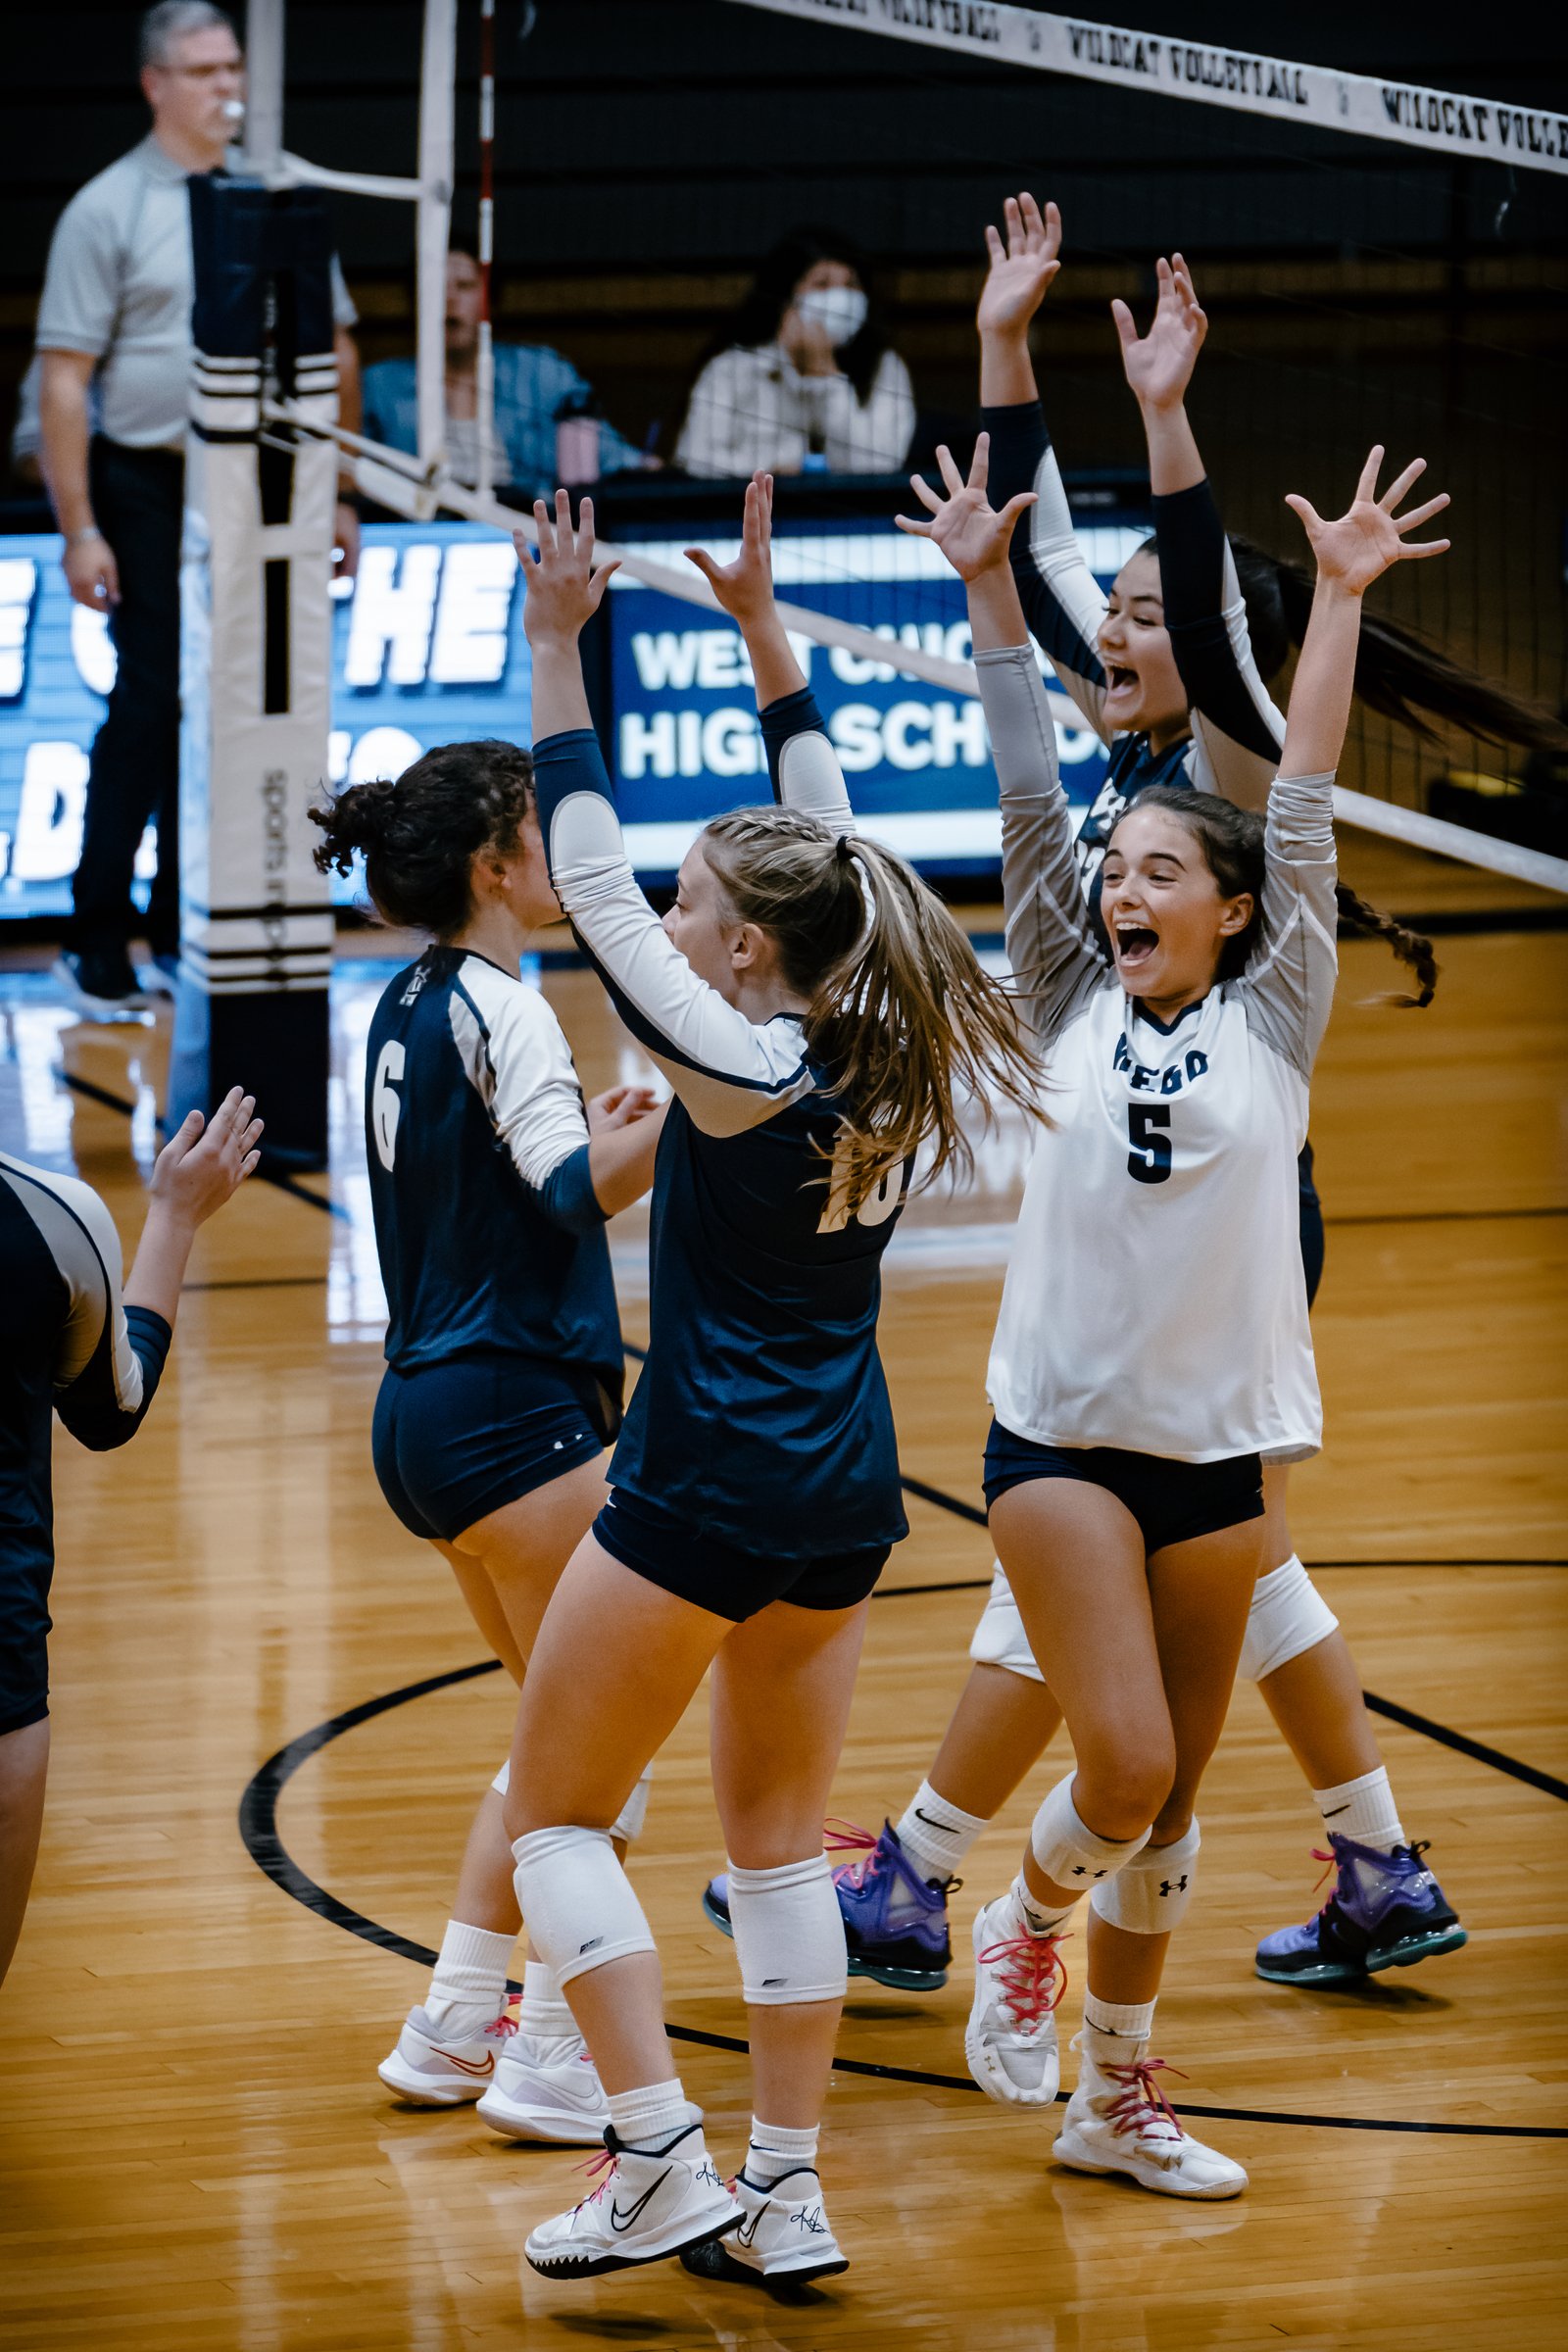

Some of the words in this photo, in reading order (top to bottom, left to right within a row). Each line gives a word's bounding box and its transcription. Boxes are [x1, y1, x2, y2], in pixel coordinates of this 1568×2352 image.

[1382, 86, 1489, 142] WILDCAT
[327, 543, 517, 686] HE
[619, 708, 768, 779] HIG
[372, 1040, 406, 1172] 6
[1128, 1102, 1173, 1184] 5
